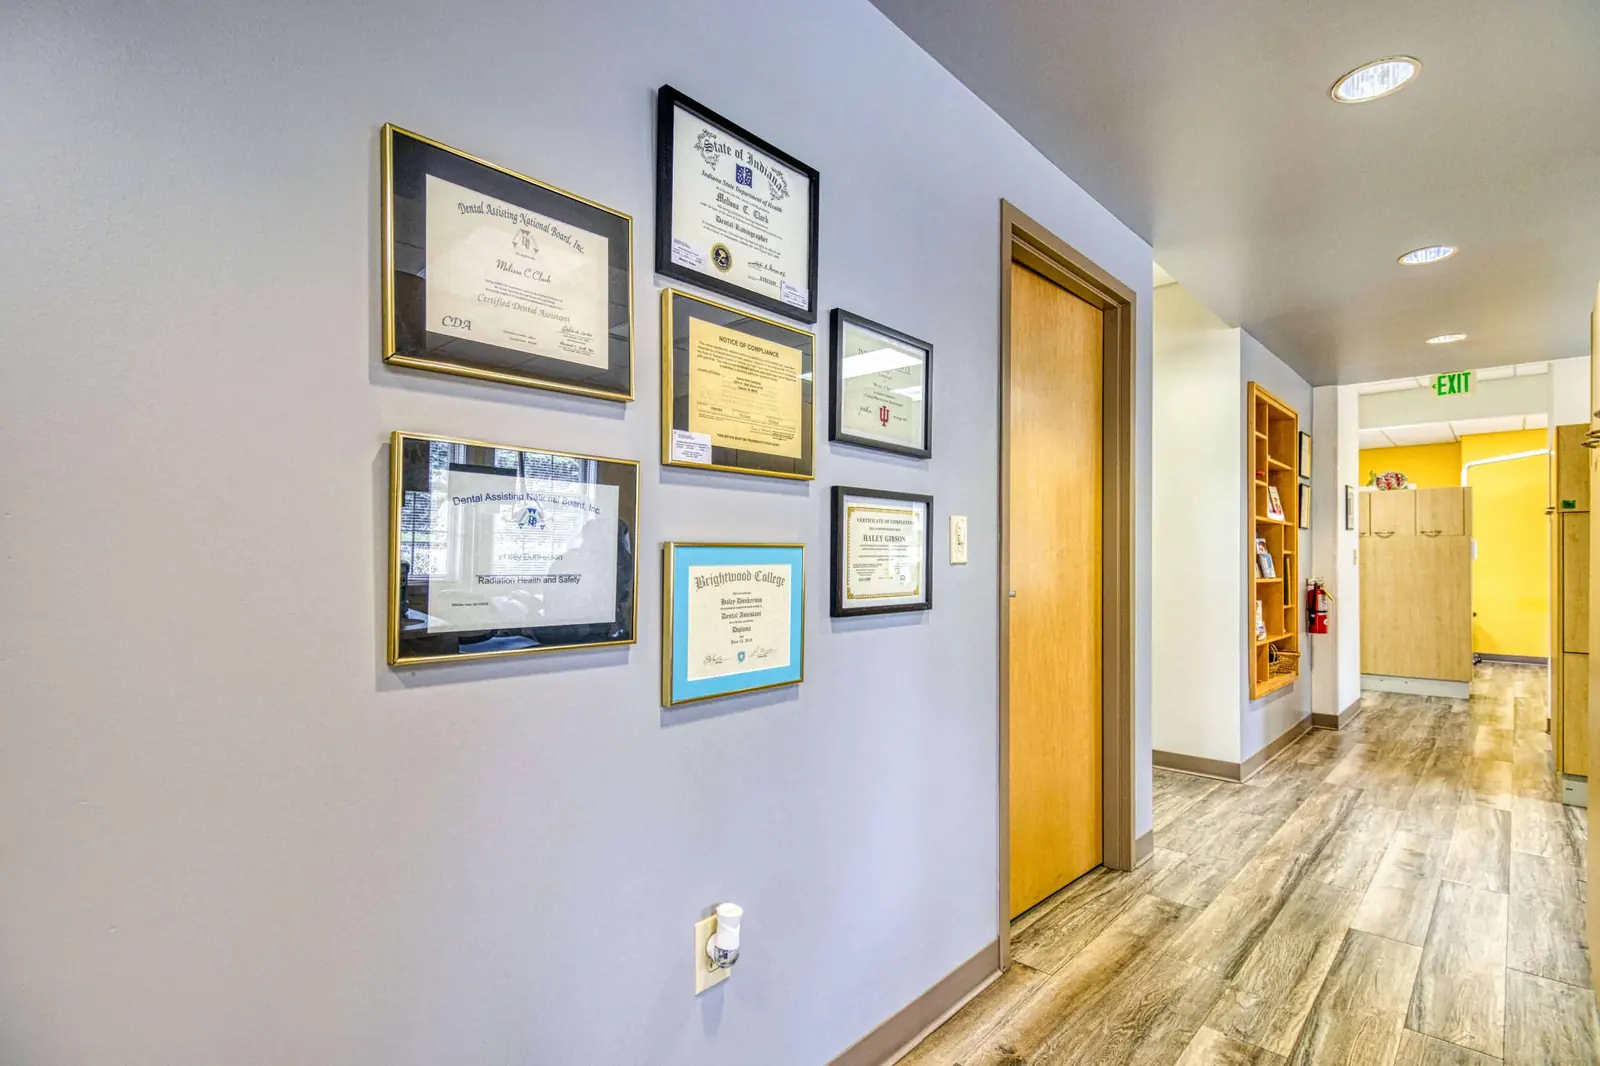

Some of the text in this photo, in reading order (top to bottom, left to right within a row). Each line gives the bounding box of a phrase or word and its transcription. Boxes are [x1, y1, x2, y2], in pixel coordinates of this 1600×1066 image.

[704, 139, 783, 191] State of Indiana
[701, 169, 721, 184] Indiana
[722, 179, 735, 191] State
[458, 201, 585, 255] Dental Assisting National Board, Inc.
[496, 259, 551, 284] Melissa C Clark
[477, 293, 511, 309] Certified
[511, 302, 537, 316] Dental
[539, 307, 570, 323] Assistant
[441, 315, 472, 331] CDA
[719, 335, 779, 358] NOTICE OF COMPLIANCE
[1437, 371, 1471, 395] EXIT
[452, 494, 483, 506] Dental
[485, 492, 524, 502] Assisting
[863, 534, 906, 543] HALEY GIBSON
[478, 575, 581, 585] Radiation Health and Safety
[694, 569, 786, 592] Brightwood College
